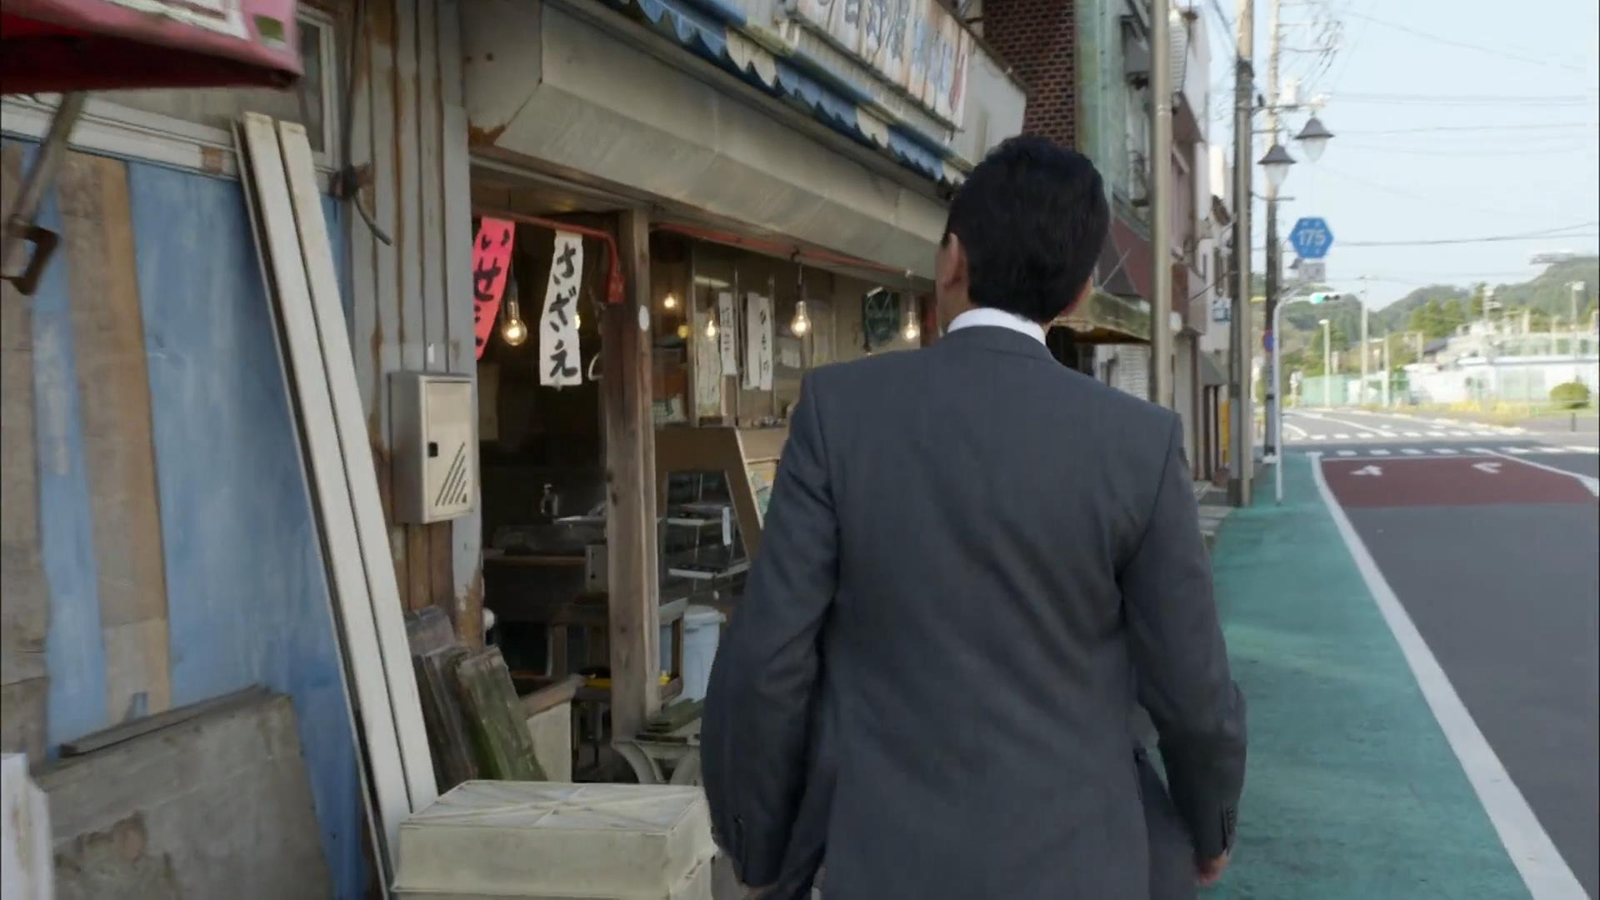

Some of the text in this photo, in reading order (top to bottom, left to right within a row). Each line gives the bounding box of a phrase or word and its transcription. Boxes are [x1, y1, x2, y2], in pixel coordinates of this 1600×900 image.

[474, 228, 511, 347] いせ
[1297, 229, 1326, 246] 175
[548, 242, 579, 378] さざえ
